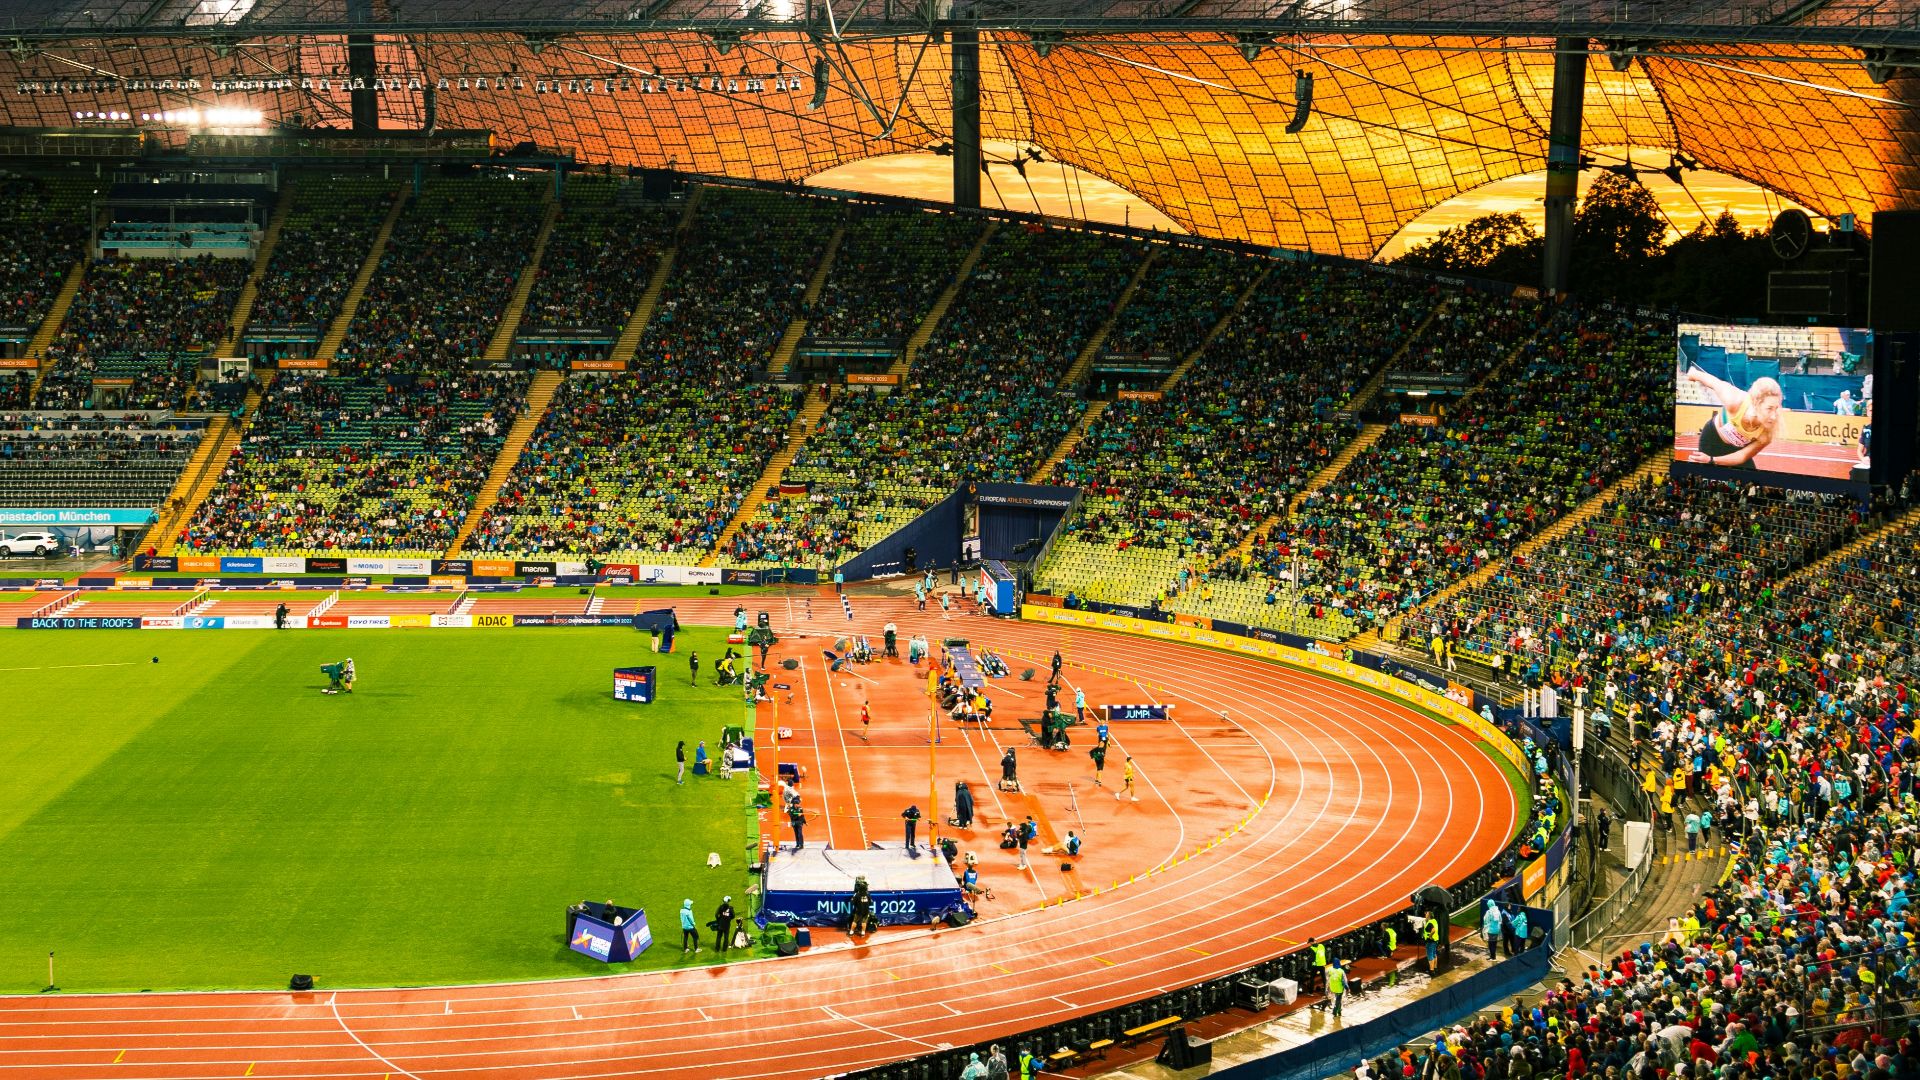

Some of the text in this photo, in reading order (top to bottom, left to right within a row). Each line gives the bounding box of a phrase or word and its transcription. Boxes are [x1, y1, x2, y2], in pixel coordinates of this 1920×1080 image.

[1844, 215, 1850, 230] 1
[1805, 421, 1859, 440] adac.de
[980, 495, 1006, 503] EUROPEAN
[1007, 497, 1032, 505] ATHLETICS
[59, 511, 110, 521] München
[654, 569, 664, 580] BR
[32, 619, 133, 628] BACK TO THE ROOFS
[478, 616, 507, 626] ADAC
[1125, 710, 1150, 719] JUMP!
[817, 900, 916, 914] MUNH 2022
